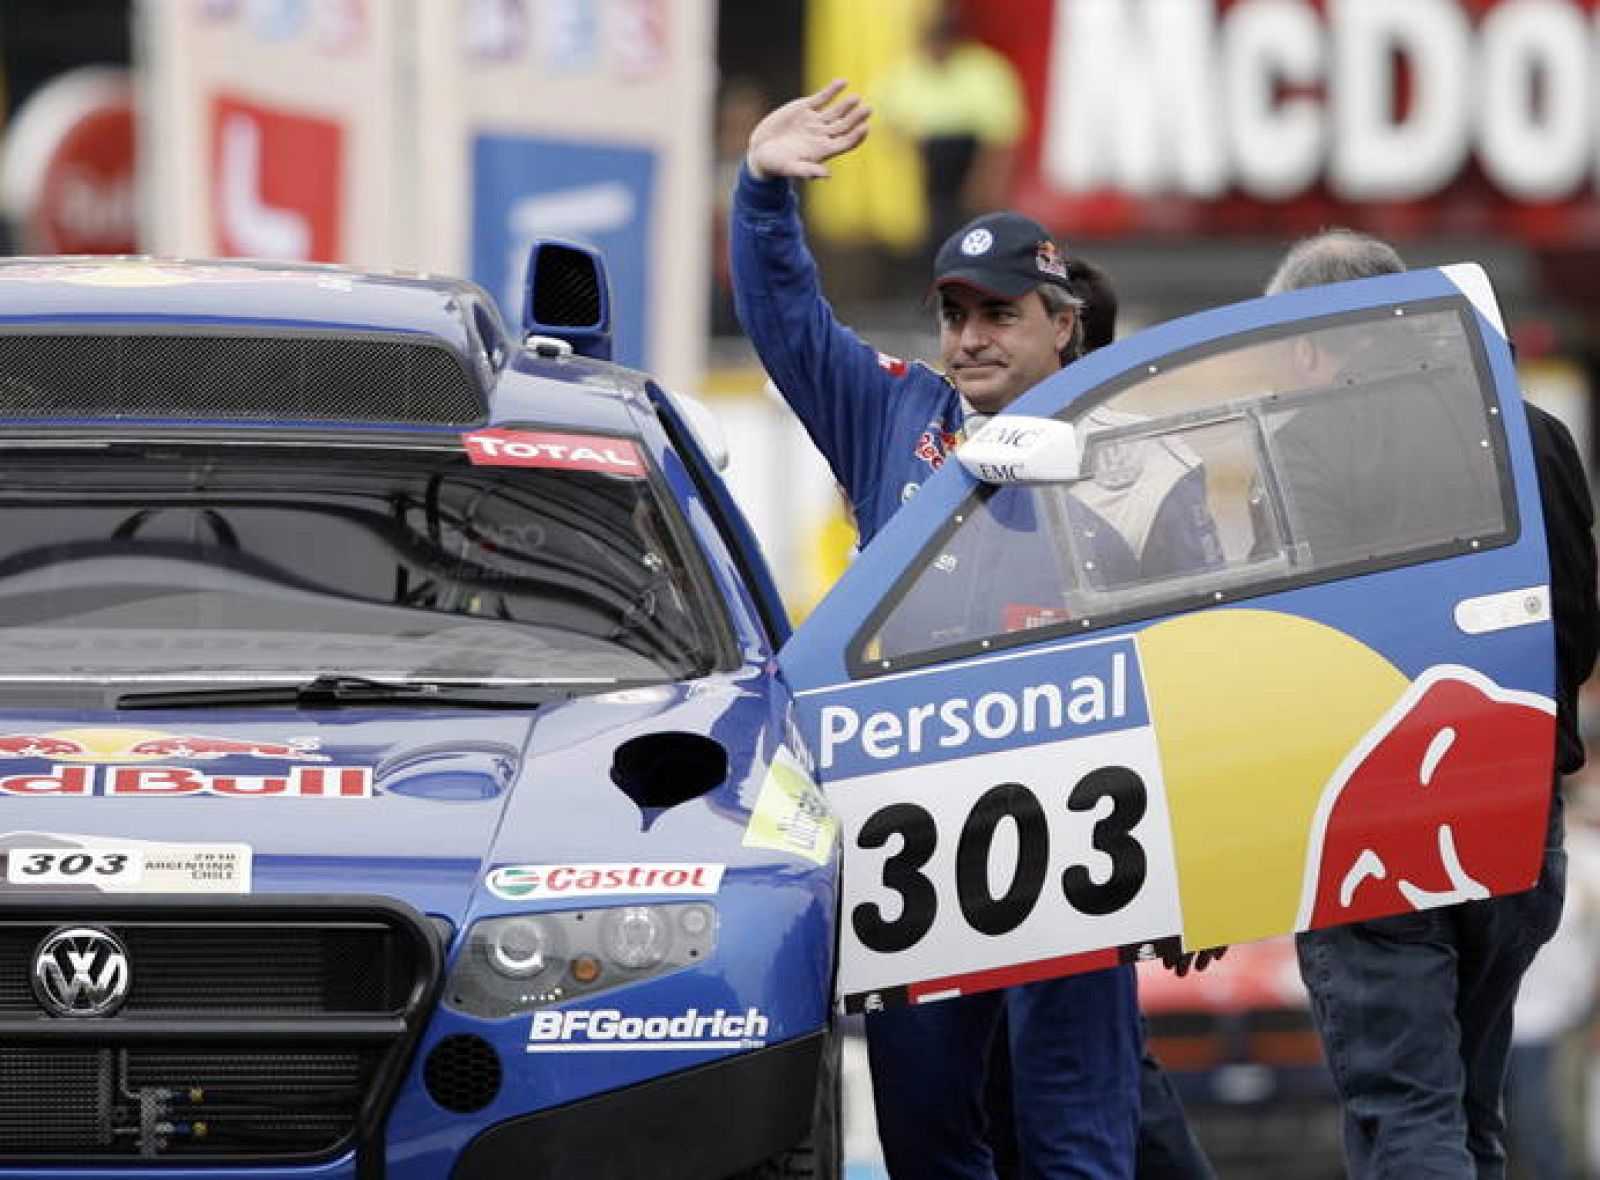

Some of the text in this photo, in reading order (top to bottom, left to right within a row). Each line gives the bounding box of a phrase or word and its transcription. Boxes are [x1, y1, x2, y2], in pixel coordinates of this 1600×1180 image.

[468, 436, 637, 467] TOTAL
[820, 651, 1127, 769] Personal
[114, 768, 364, 795] Bull
[22, 853, 128, 876] 303
[145, 862, 234, 871] ARGENTINA
[852, 765, 1149, 954] 303
[192, 871, 232, 880] CHILE
[546, 867, 706, 892] Castrol
[529, 1007, 769, 1041] BFGoodrich
